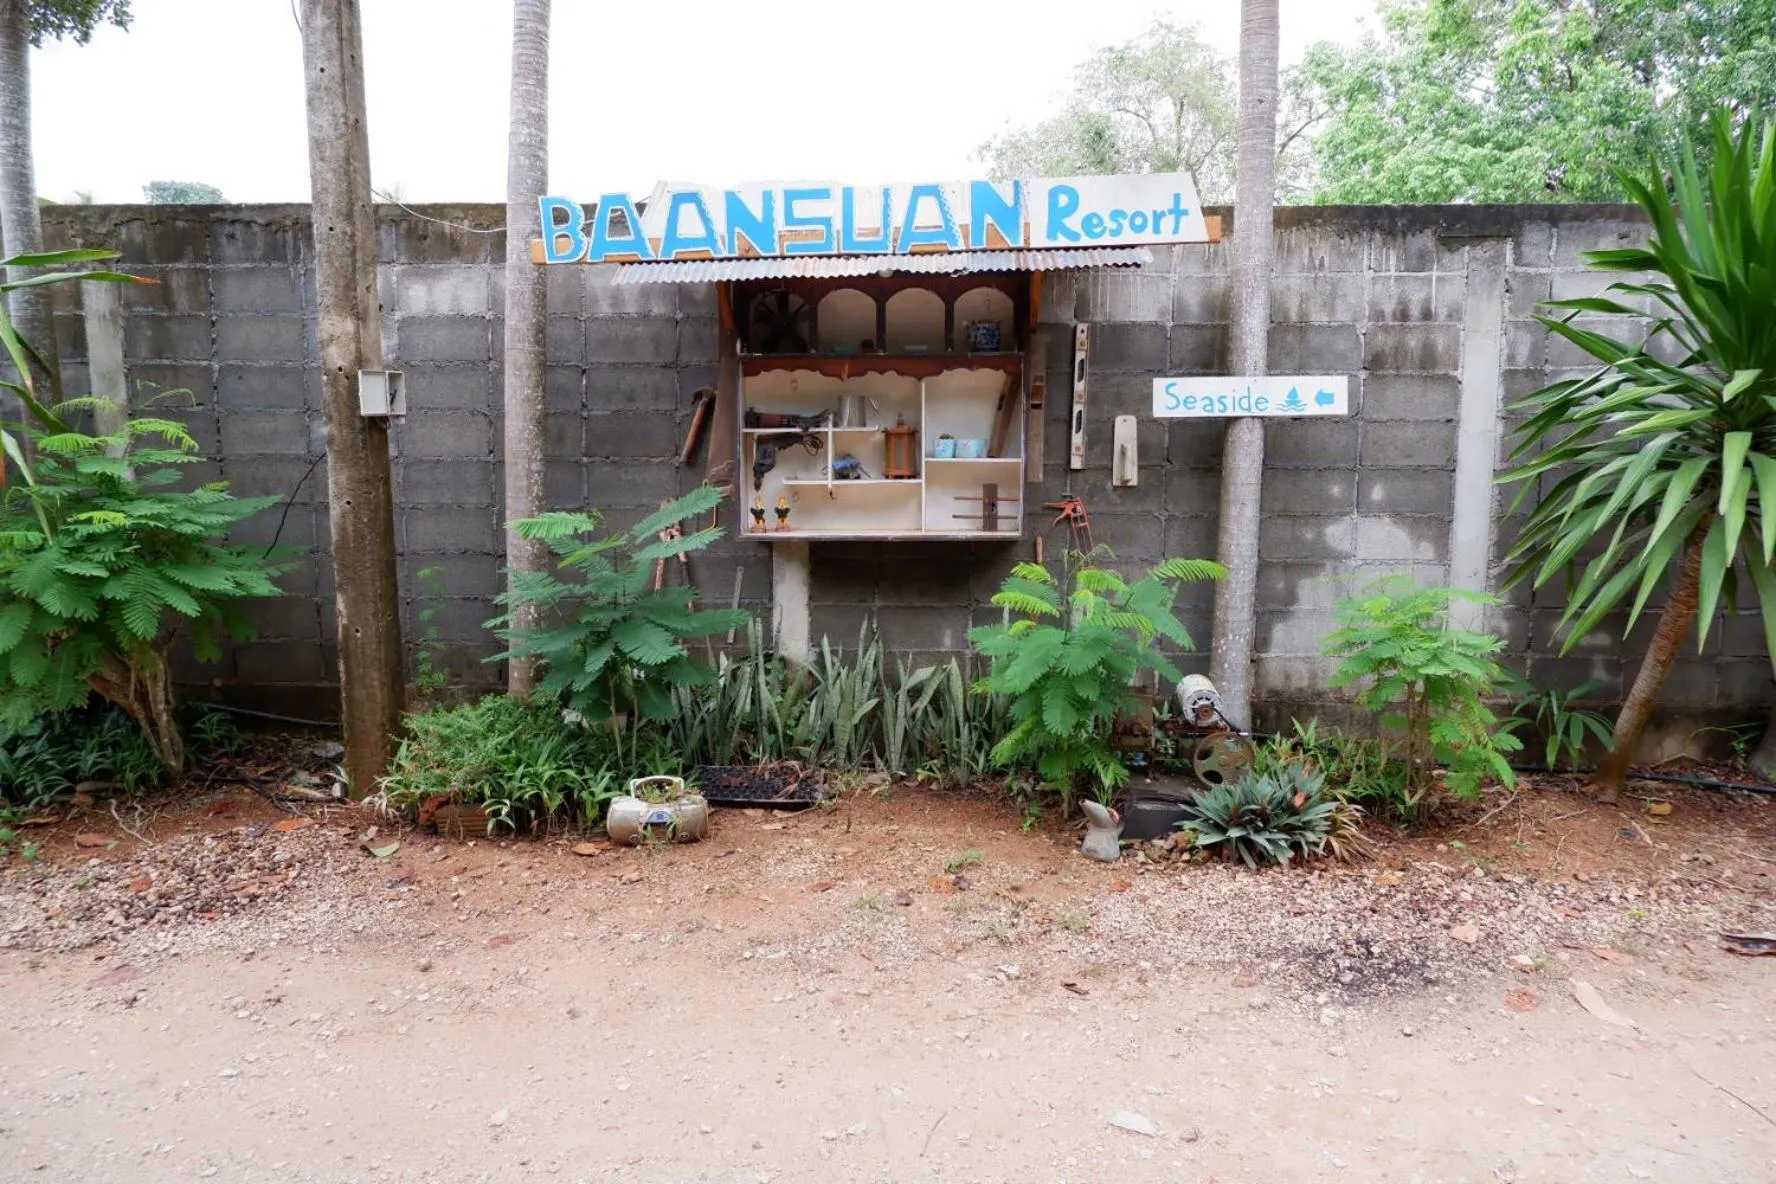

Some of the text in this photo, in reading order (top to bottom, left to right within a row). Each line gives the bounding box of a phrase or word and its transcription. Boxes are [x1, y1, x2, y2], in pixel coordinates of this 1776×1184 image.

[539, 179, 1189, 263] BAANSUAN Resort
[1164, 382, 1270, 414] Seaside
